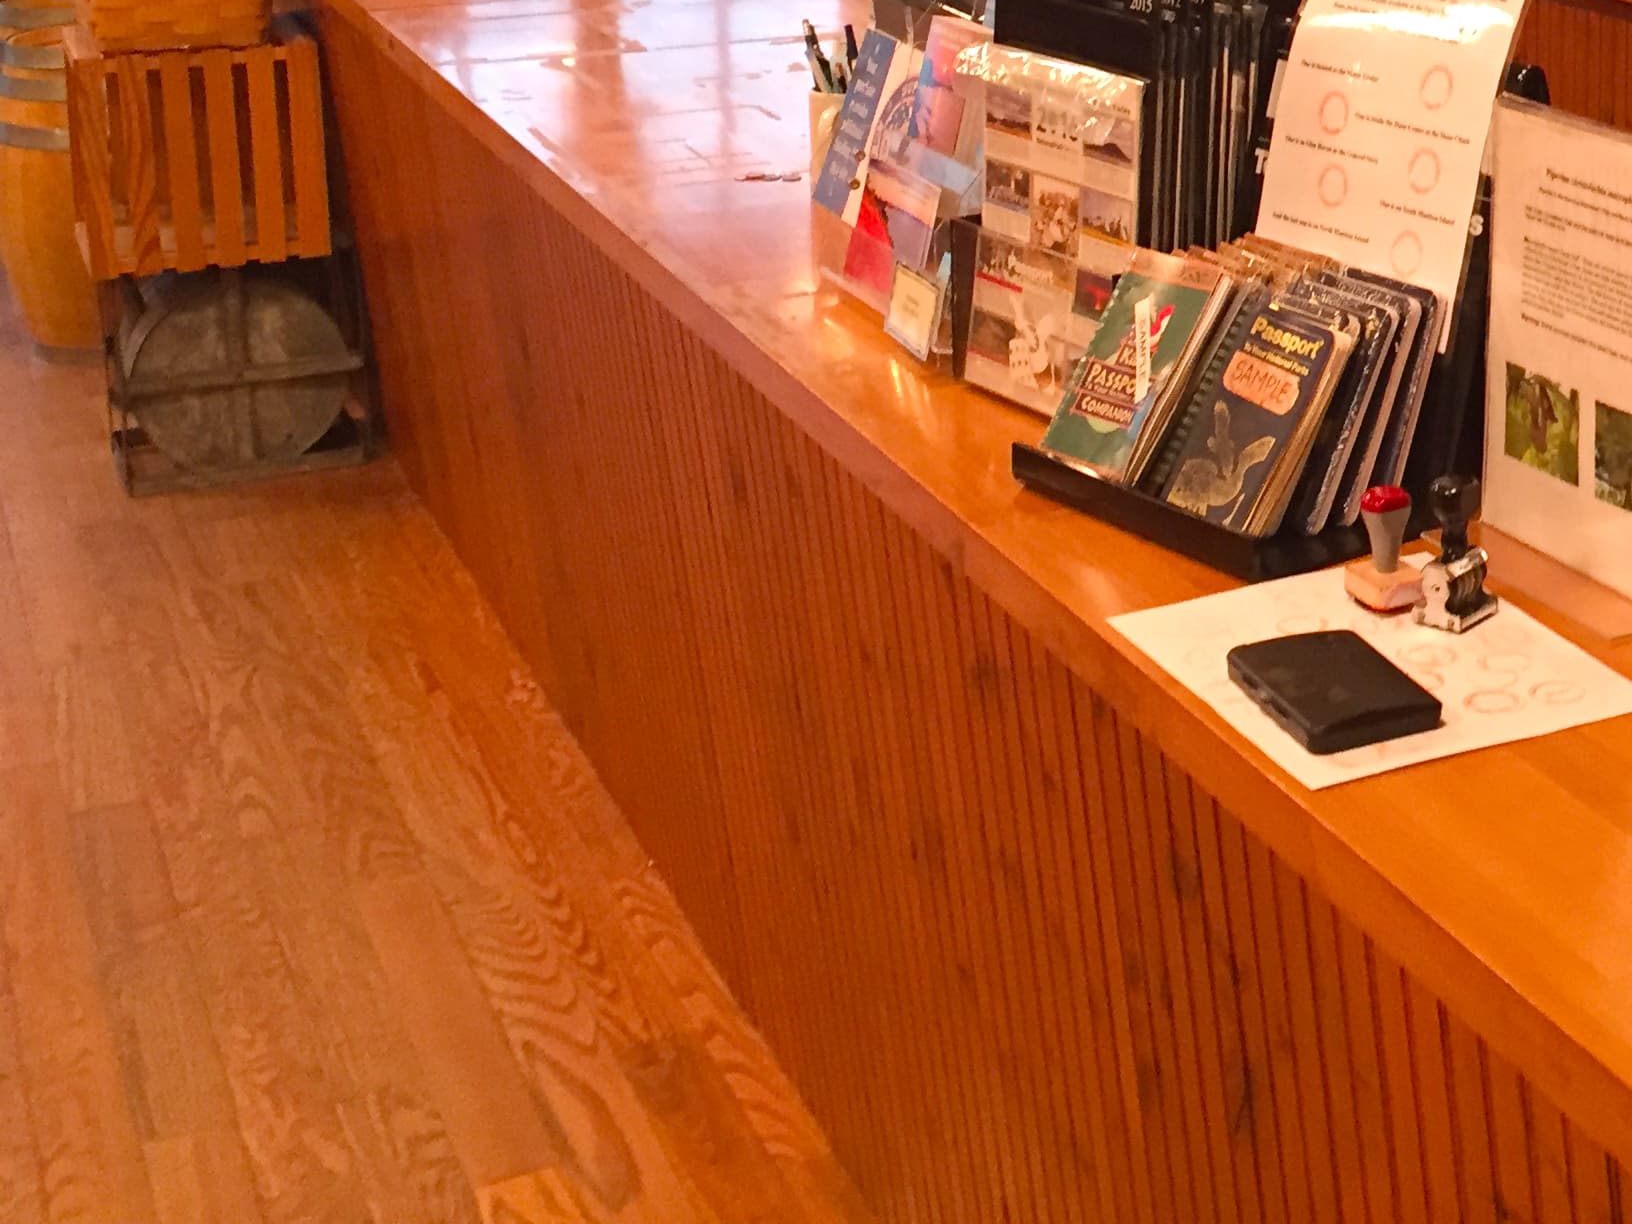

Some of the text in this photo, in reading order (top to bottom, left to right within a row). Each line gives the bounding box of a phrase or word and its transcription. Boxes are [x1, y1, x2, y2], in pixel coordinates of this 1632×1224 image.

[1250, 316, 1325, 361] Passport
[1086, 363, 1136, 394] PASSPO
[1234, 359, 1292, 397] SAMPLE
[1081, 396, 1132, 423] COMPANION
